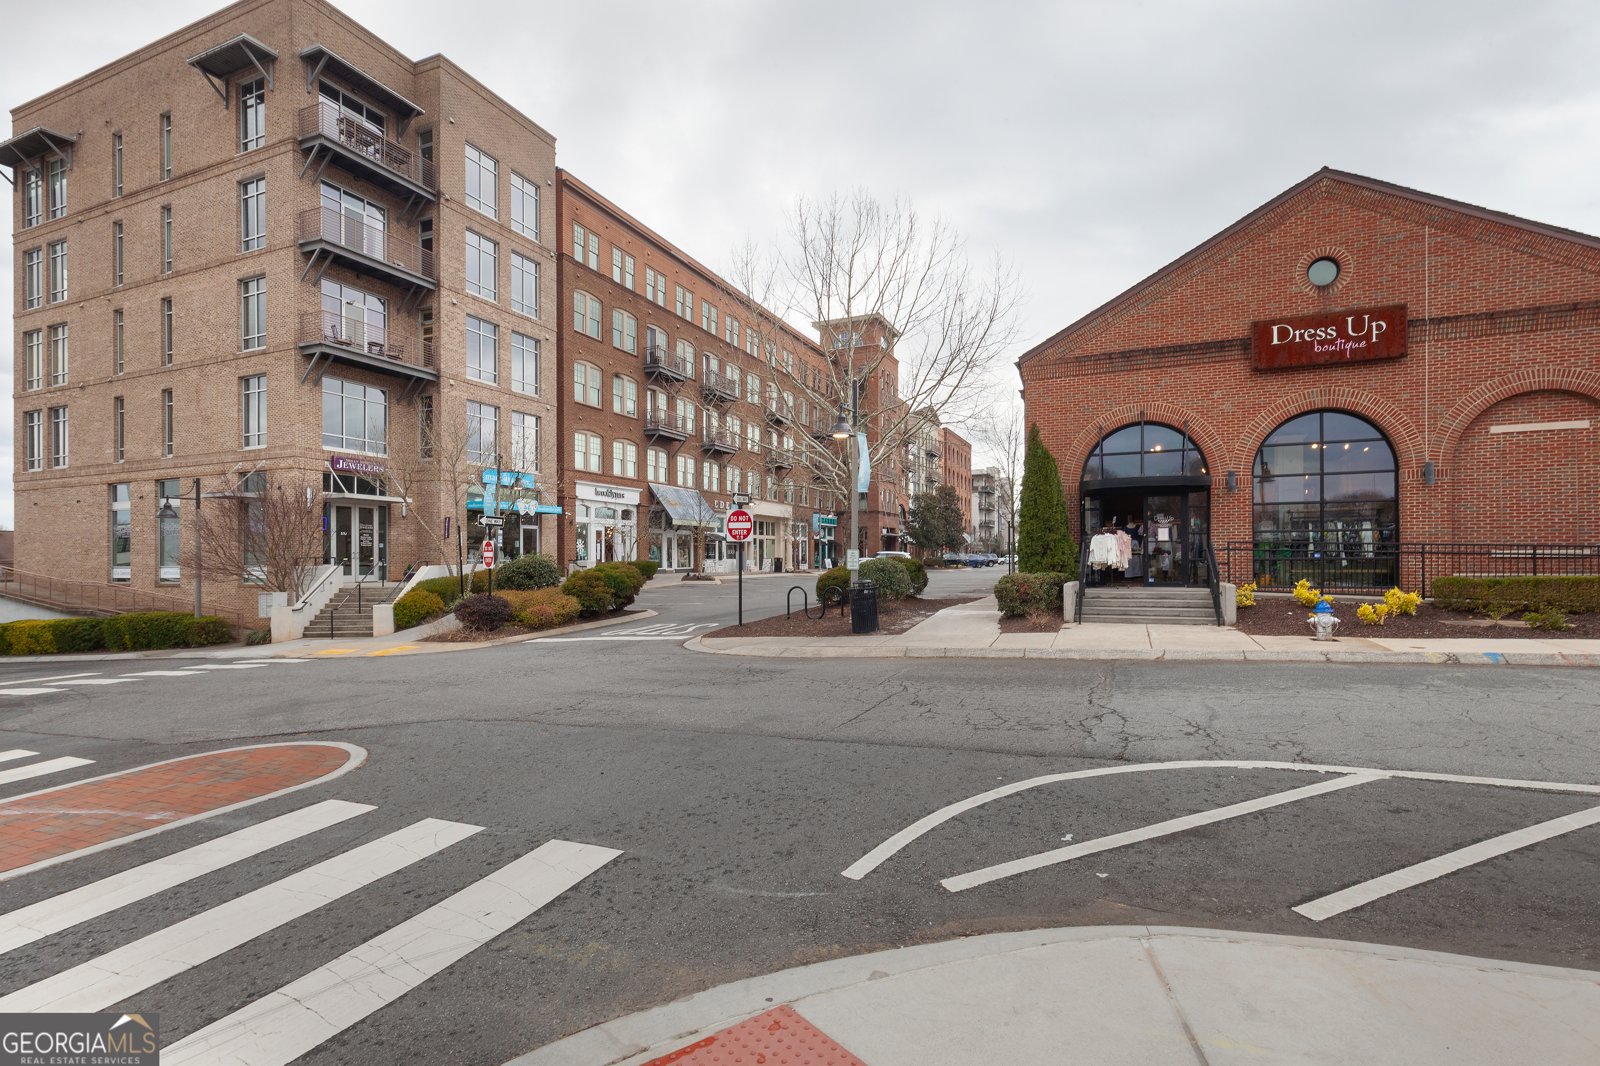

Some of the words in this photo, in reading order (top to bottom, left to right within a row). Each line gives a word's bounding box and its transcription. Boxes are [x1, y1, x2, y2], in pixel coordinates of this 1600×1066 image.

[1271, 324, 1337, 345] Dress
[1345, 314, 1387, 343] Up
[1314, 338, 1367, 358] boutique
